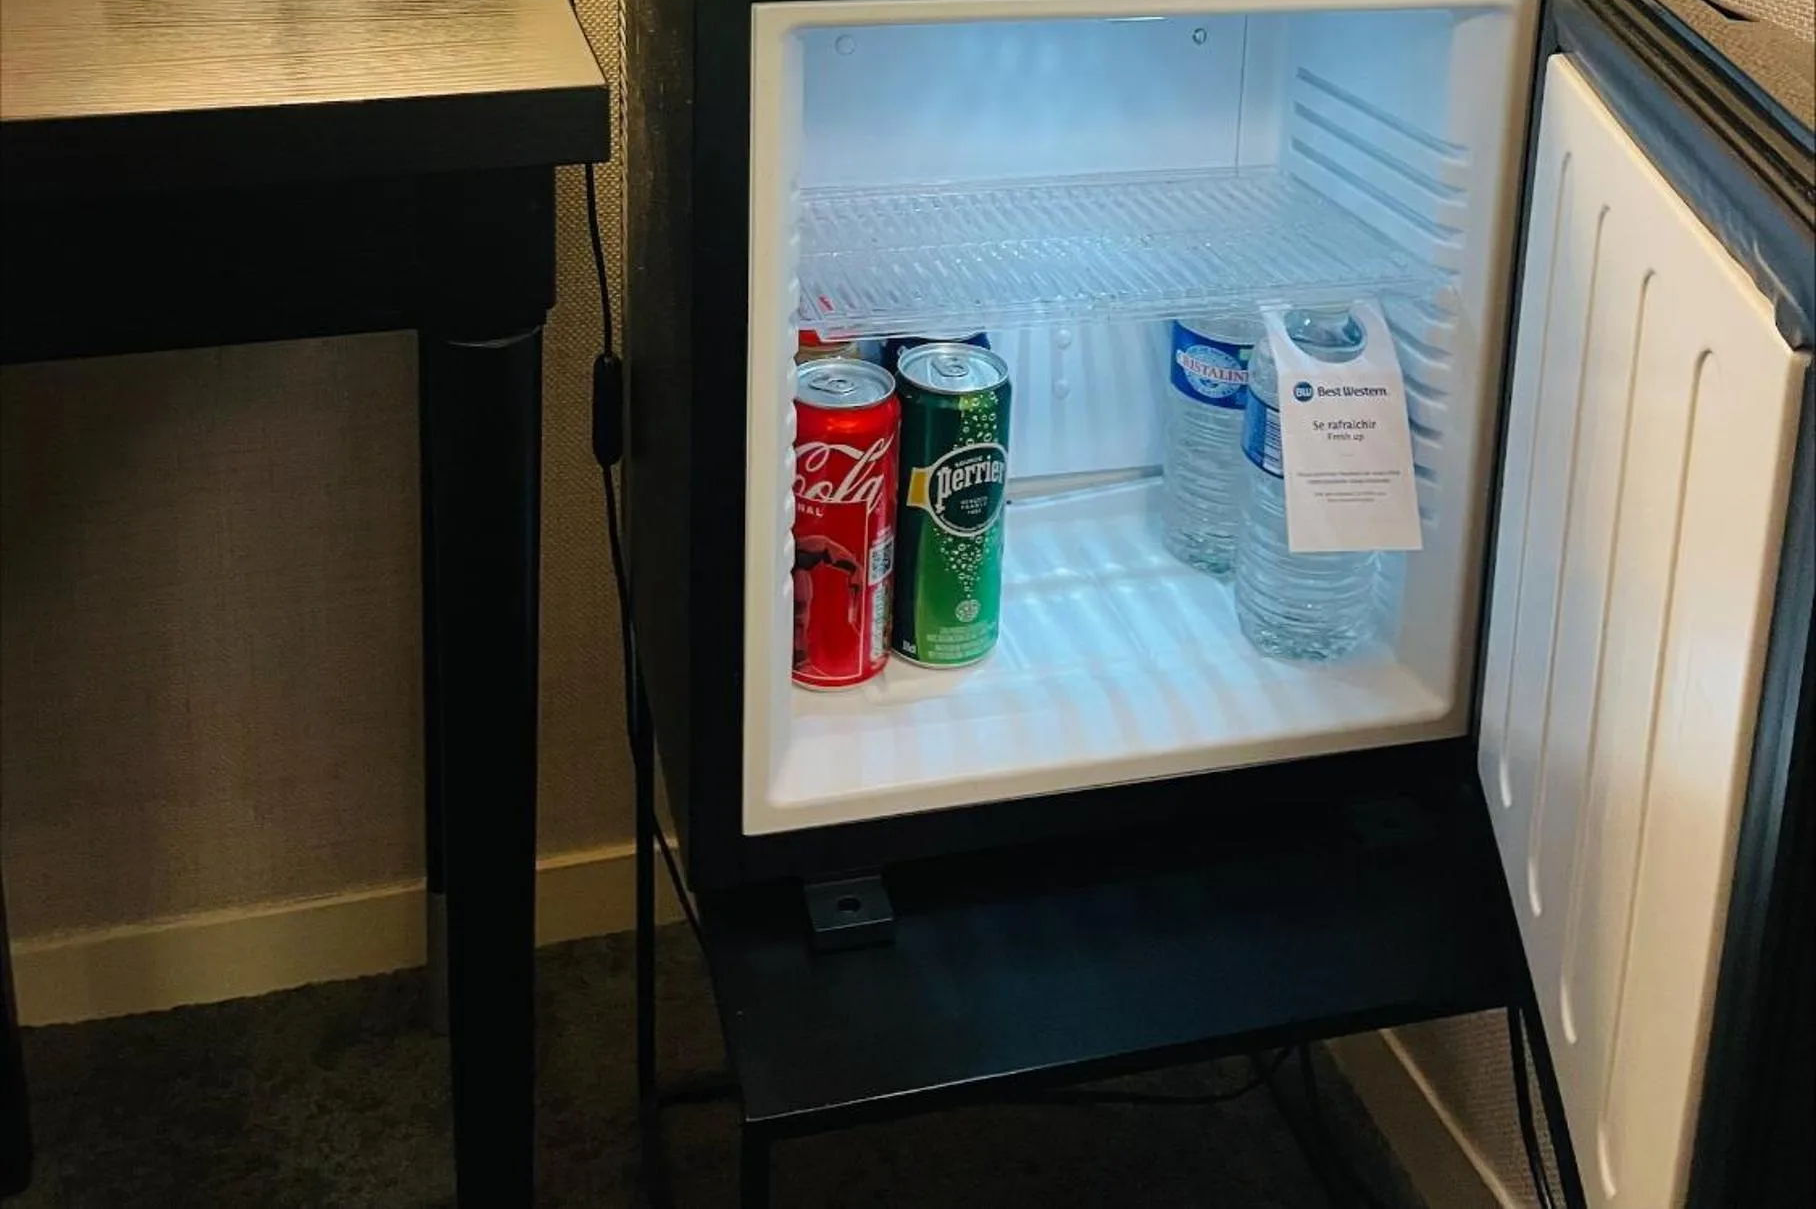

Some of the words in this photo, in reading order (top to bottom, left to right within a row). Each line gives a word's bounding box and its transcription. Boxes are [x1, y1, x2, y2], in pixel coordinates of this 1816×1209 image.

[1177, 353, 1249, 382] RISTALIN
[1317, 386, 1341, 397] Best
[1343, 386, 1388, 397] Western
[1313, 420, 1325, 430] Se
